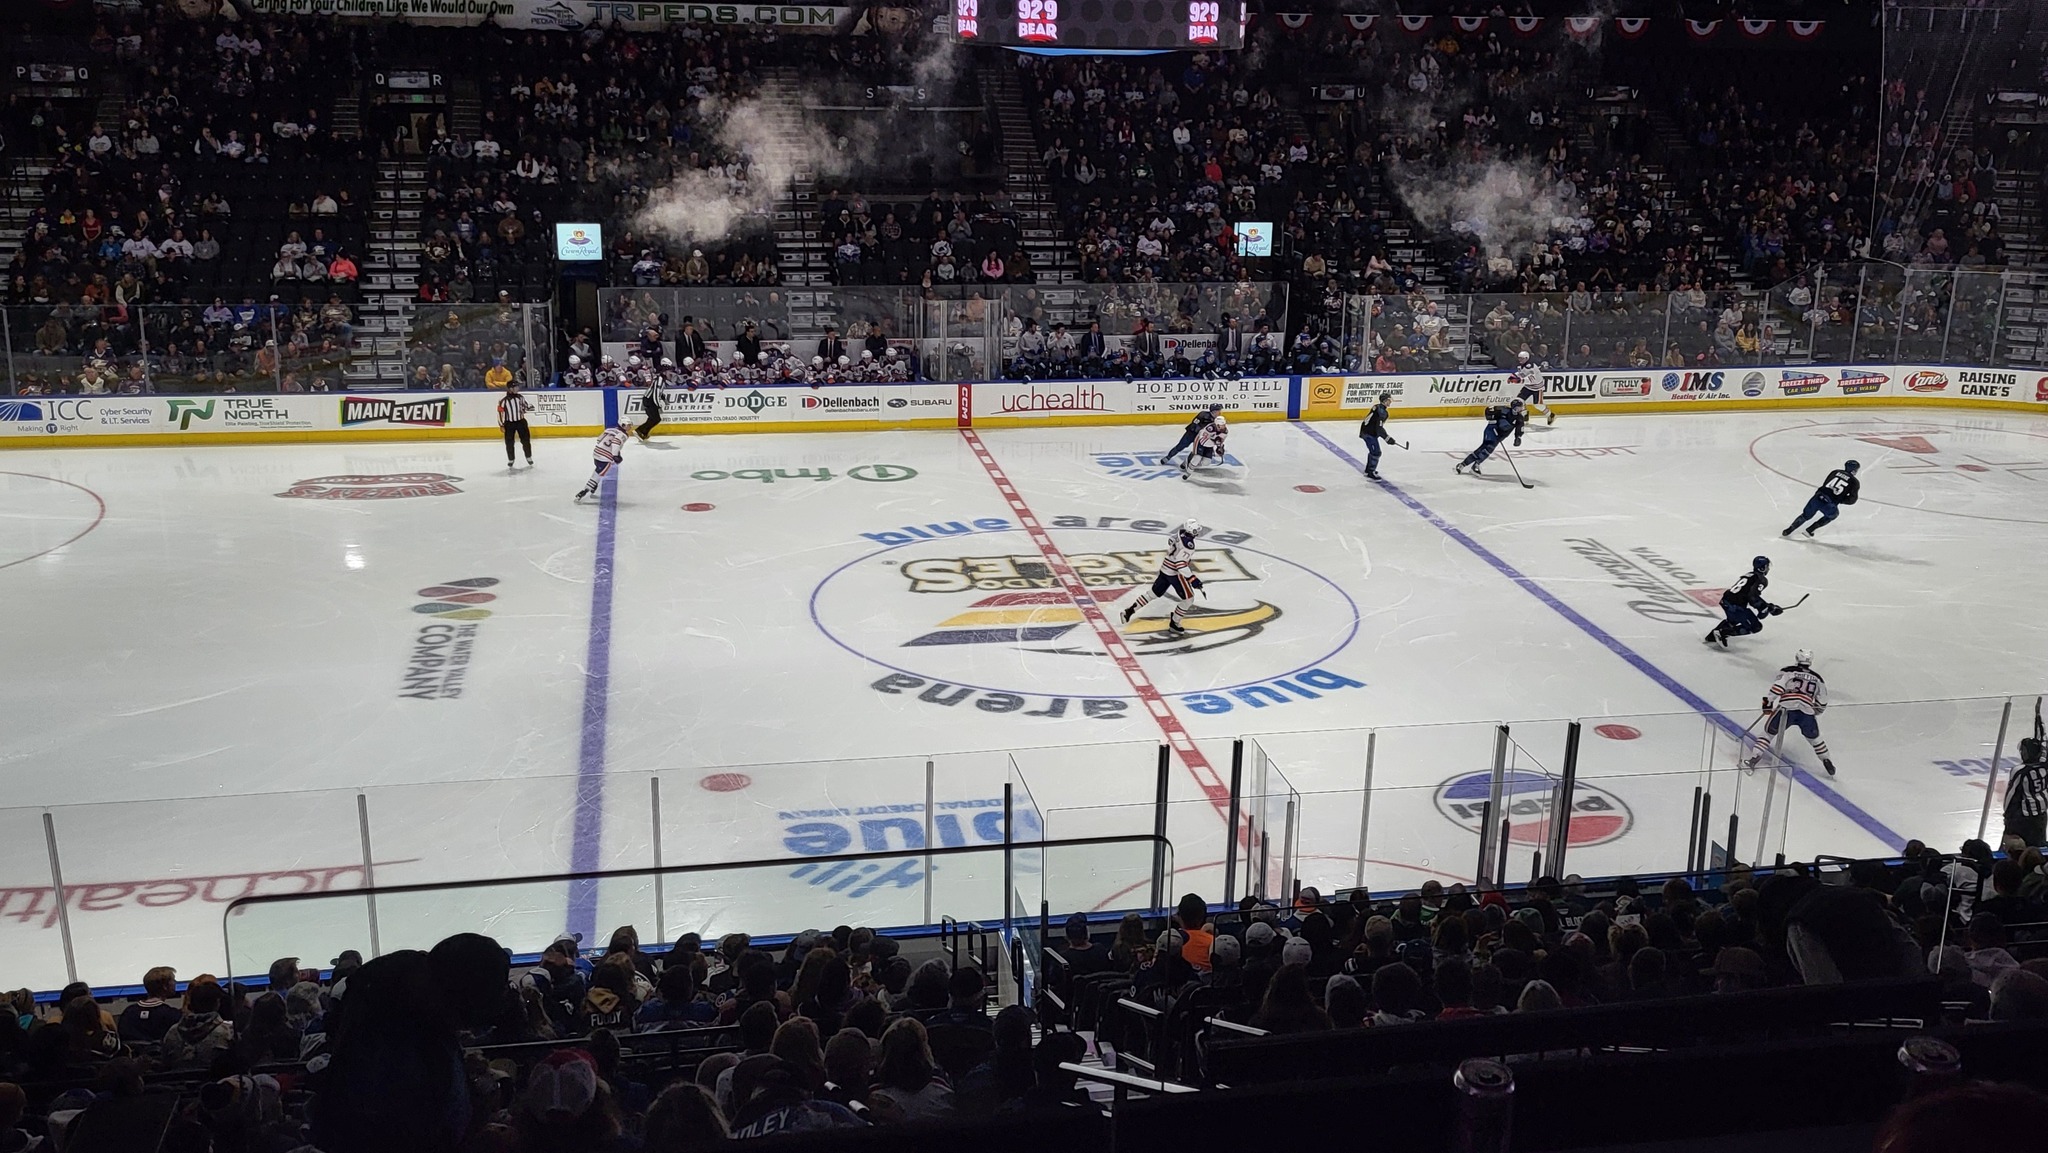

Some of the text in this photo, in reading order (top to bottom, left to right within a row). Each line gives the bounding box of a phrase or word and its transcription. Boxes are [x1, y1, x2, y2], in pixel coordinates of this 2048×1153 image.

[250, 0, 514, 15] Caring For Your Children Like We Would Our Own
[588, 2, 835, 25] TRPEDS.COM
[958, 19, 978, 35] BEAR
[1018, 22, 1058, 39] BEAR
[1189, 25, 1219, 41] BEAR
[16, 65, 89, 80] P Q
[375, 73, 443, 86] Q R
[866, 87, 926, 99] S S
[1310, 86, 1365, 98] T U
[1631, 89, 1639, 100] V
[1986, 93, 1996, 105] V
[1181, 339, 1217, 349] Dellenba
[1429, 375, 1502, 393] Nutrien
[1543, 375, 1597, 392] TRULY
[1612, 380, 1639, 388] TRULY
[1680, 372, 1725, 391] IMS
[1781, 377, 1825, 388] BREEZE THRU
[1839, 376, 1885, 387] BREEZE THRU
[1958, 372, 2017, 385] RAISING
[1136, 380, 1282, 393] HOEDOWN HILL
[1960, 384, 2011, 397] CANE'S
[223, 399, 273, 409] TRUE
[539, 394, 567, 402] POWELL
[665, 392, 716, 404] URVIS
[724, 395, 788, 408] DODGE
[823, 396, 880, 408] Dellenbach
[960, 386, 970, 420] CCM
[1002, 384, 1104, 411] uchealth
[1440, 396, 1511, 405] Feeding the Future
[47, 399, 94, 421] ICC
[99, 408, 153, 417] Cyber Security
[347, 402, 446, 421] MAIN EVENT
[539, 403, 567, 411] WELDING
[1168, 402, 1239, 411] SNOWBARD
[1252, 401, 1280, 409] TUBE
[101, 417, 108, 425] &
[224, 410, 289, 420] NORTH
[17, 425, 44, 433] Making
[60, 424, 79, 432] Right
[689, 468, 838, 483] fnbo
[1825, 476, 1849, 496] 45
[860, 516, 1011, 546] blue
[1629, 546, 1706, 586] TOYOTA
[397, 624, 456, 701] COMPANY
[438, 624, 478, 699] THE WATER VALLEY
[871, 668, 1368, 719] blue arena
[0, 865, 372, 929] uchealt
